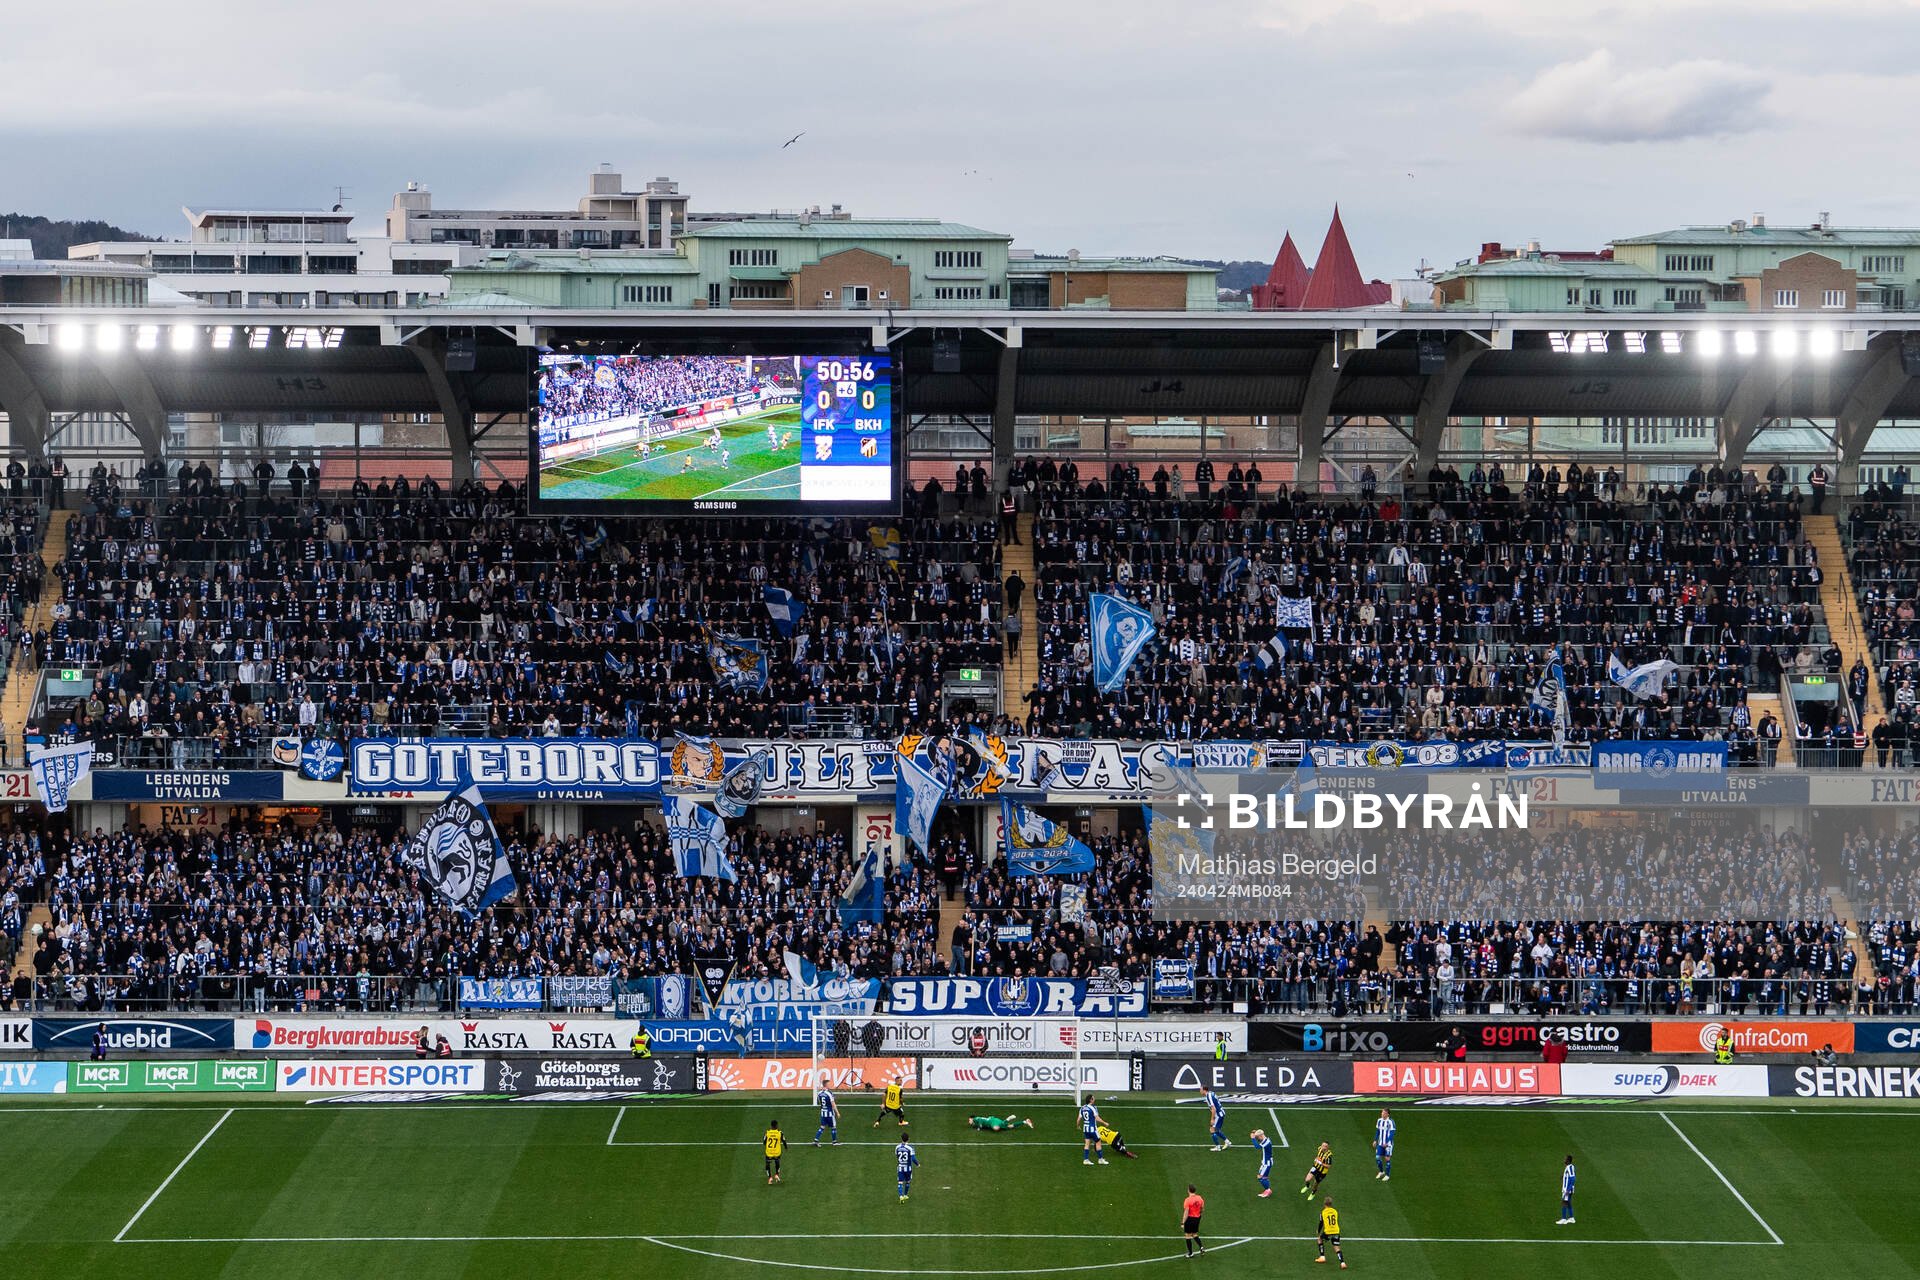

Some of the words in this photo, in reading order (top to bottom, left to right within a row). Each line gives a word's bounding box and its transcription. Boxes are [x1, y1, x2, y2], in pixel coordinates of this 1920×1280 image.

[817, 362, 874, 381] 50:56
[838, 385, 853, 395] +6
[818, 391, 830, 409] 0
[862, 391, 874, 409] 0
[813, 419, 834, 430] IFK
[855, 419, 882, 430] BKH
[693, 501, 737, 509] SAMSUNG
[50, 734, 75, 744] THE
[1194, 745, 1246, 753] SEKTION
[1308, 745, 1368, 767] GFK
[354, 740, 659, 789] GÖTEBORG
[1196, 753, 1247, 767] OSLO
[1598, 753, 1642, 774] BRIG
[1676, 753, 1722, 774] ADEN
[146, 773, 230, 784] LEGENDENS
[155, 787, 222, 797] UTVALDA
[1490, 778, 1558, 801] FAT21
[1682, 791, 1747, 802] UTVALDA
[893, 979, 981, 1012] SUP
[464, 1033, 528, 1049] RASTA
[552, 1033, 616, 1049] RASTA
[1481, 1024, 1537, 1046] ggm
[1730, 1027, 1808, 1047] InfraCom
[84, 1068, 120, 1081] MCR
[152, 1067, 189, 1081] MCR
[221, 1066, 258, 1080] MCR
[310, 1065, 474, 1086] INTERSPORT
[541, 1061, 620, 1076] Göteborgs
[697, 1057, 705, 1090] SELECT
[1133, 1056, 1142, 1090] SELECT
[535, 1075, 641, 1089] Metallpartier
[1213, 1066, 1321, 1088] ELEDA
[1377, 1067, 1534, 1088] BAUHAUS
[1615, 1073, 1663, 1086] SUPER
[1795, 1066, 1920, 1097] SERNEK
[821, 1096, 827, 1106] 5
[888, 1091, 897, 1103] 10
[768, 1137, 779, 1149] 27
[898, 1151, 909, 1162] 23
[1326, 1214, 1336, 1226] 16
